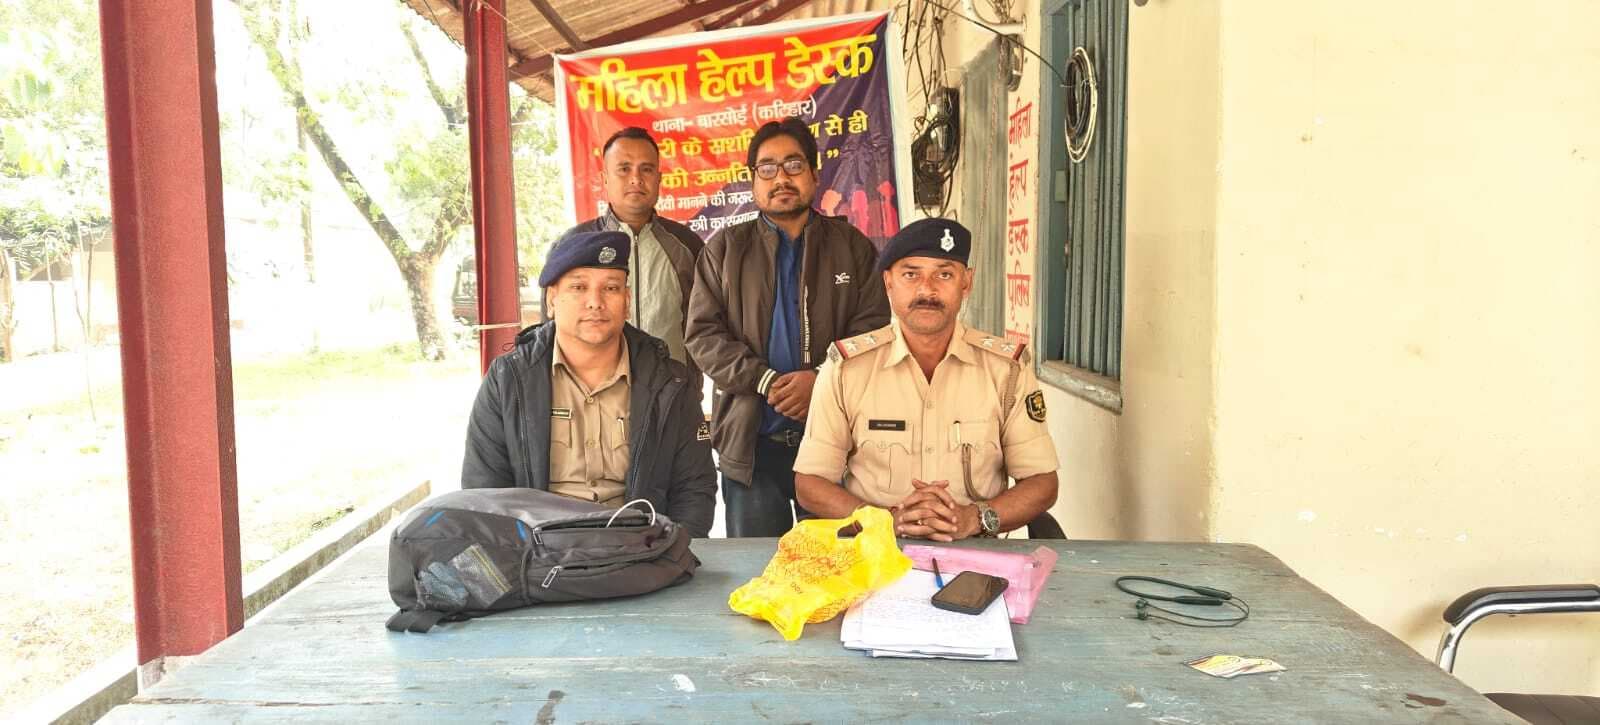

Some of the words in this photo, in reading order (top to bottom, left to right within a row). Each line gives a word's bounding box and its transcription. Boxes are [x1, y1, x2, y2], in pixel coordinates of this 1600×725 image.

[568, 57, 688, 113] महिला
[696, 48, 775, 103] हेल्प
[783, 33, 877, 90] डेस्क
[681, 136, 703, 156] के
[824, 114, 844, 136] से
[847, 110, 868, 134] ही
[696, 103, 747, 128] बारसोई
[752, 94, 816, 127] (कटिहार)
[1009, 97, 1032, 145] महिला
[661, 167, 688, 189] की
[710, 190, 726, 207] की
[1009, 152, 1029, 207] हेल्प
[1008, 208, 1029, 256] डेस्क
[1007, 260, 1031, 321] पुलिस
